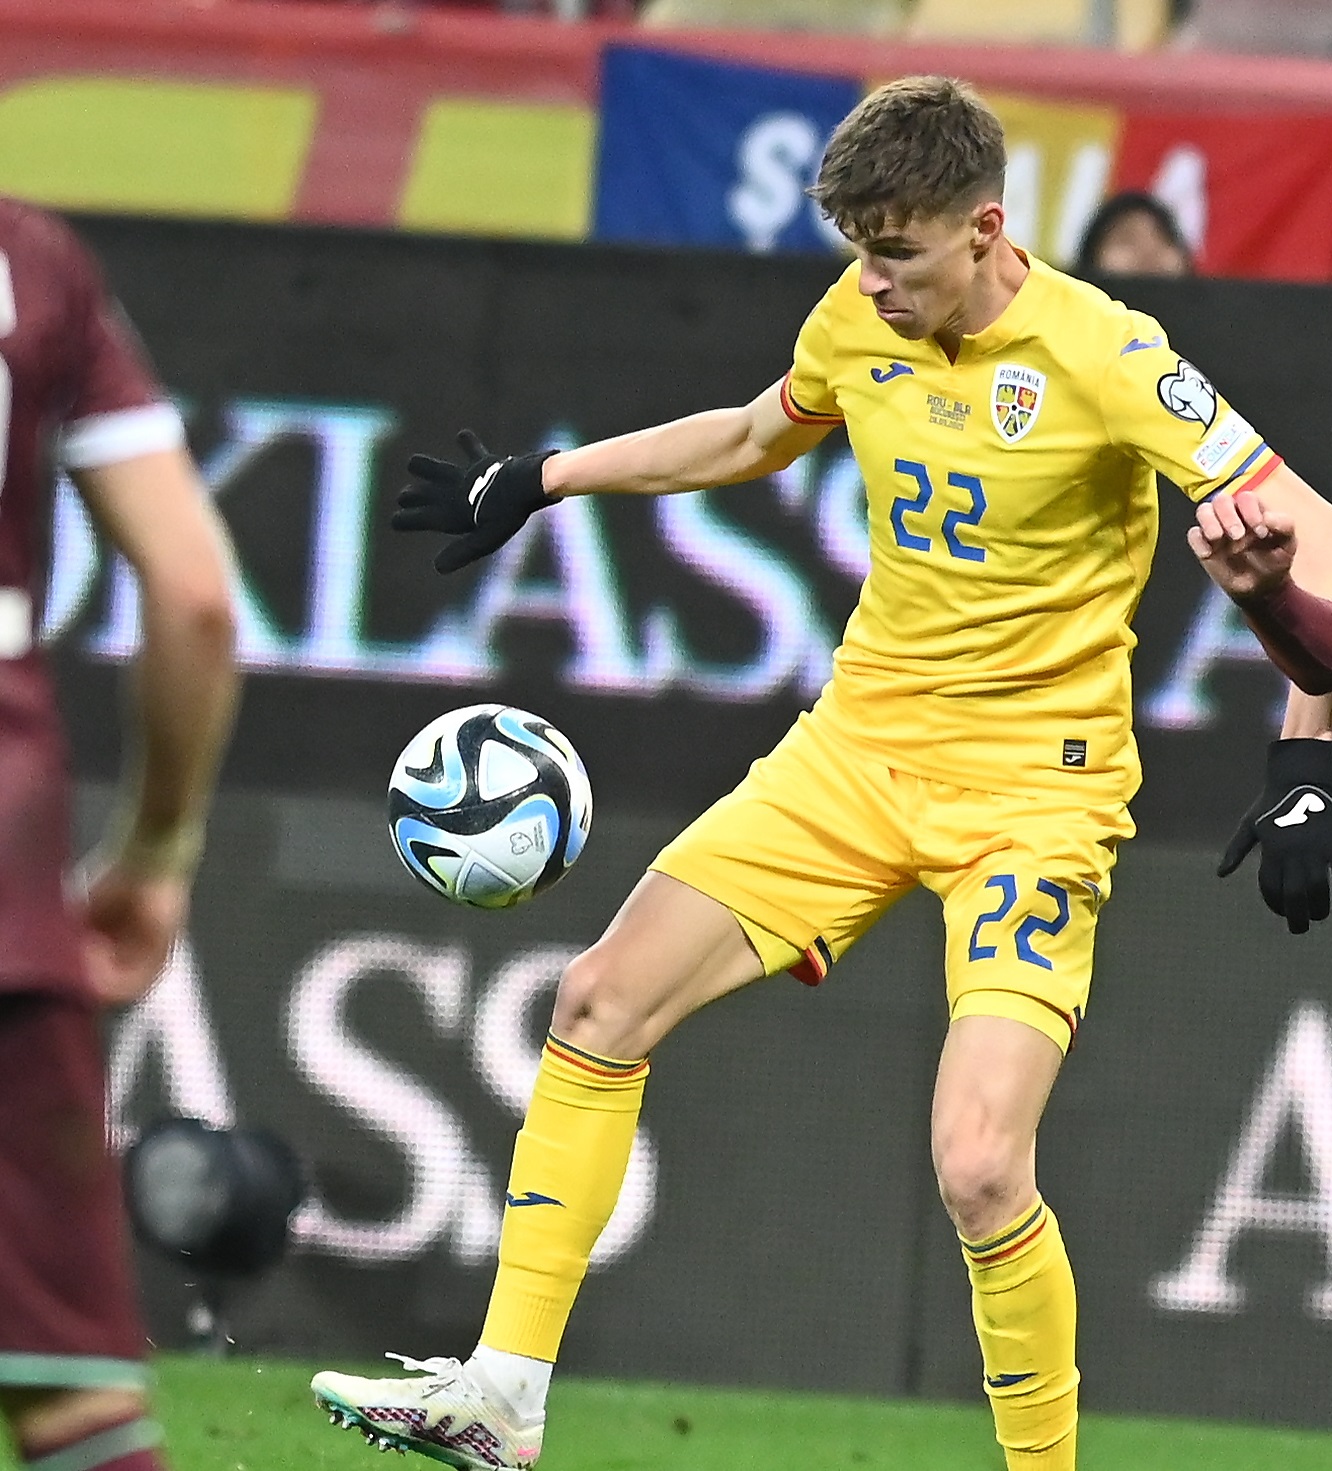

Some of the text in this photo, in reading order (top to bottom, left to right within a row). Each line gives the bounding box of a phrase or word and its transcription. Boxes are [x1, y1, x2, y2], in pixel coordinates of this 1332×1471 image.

[999, 369, 1040, 388] ROMÂNIA
[889, 457, 988, 563] 22
[968, 873, 1071, 972] 22
